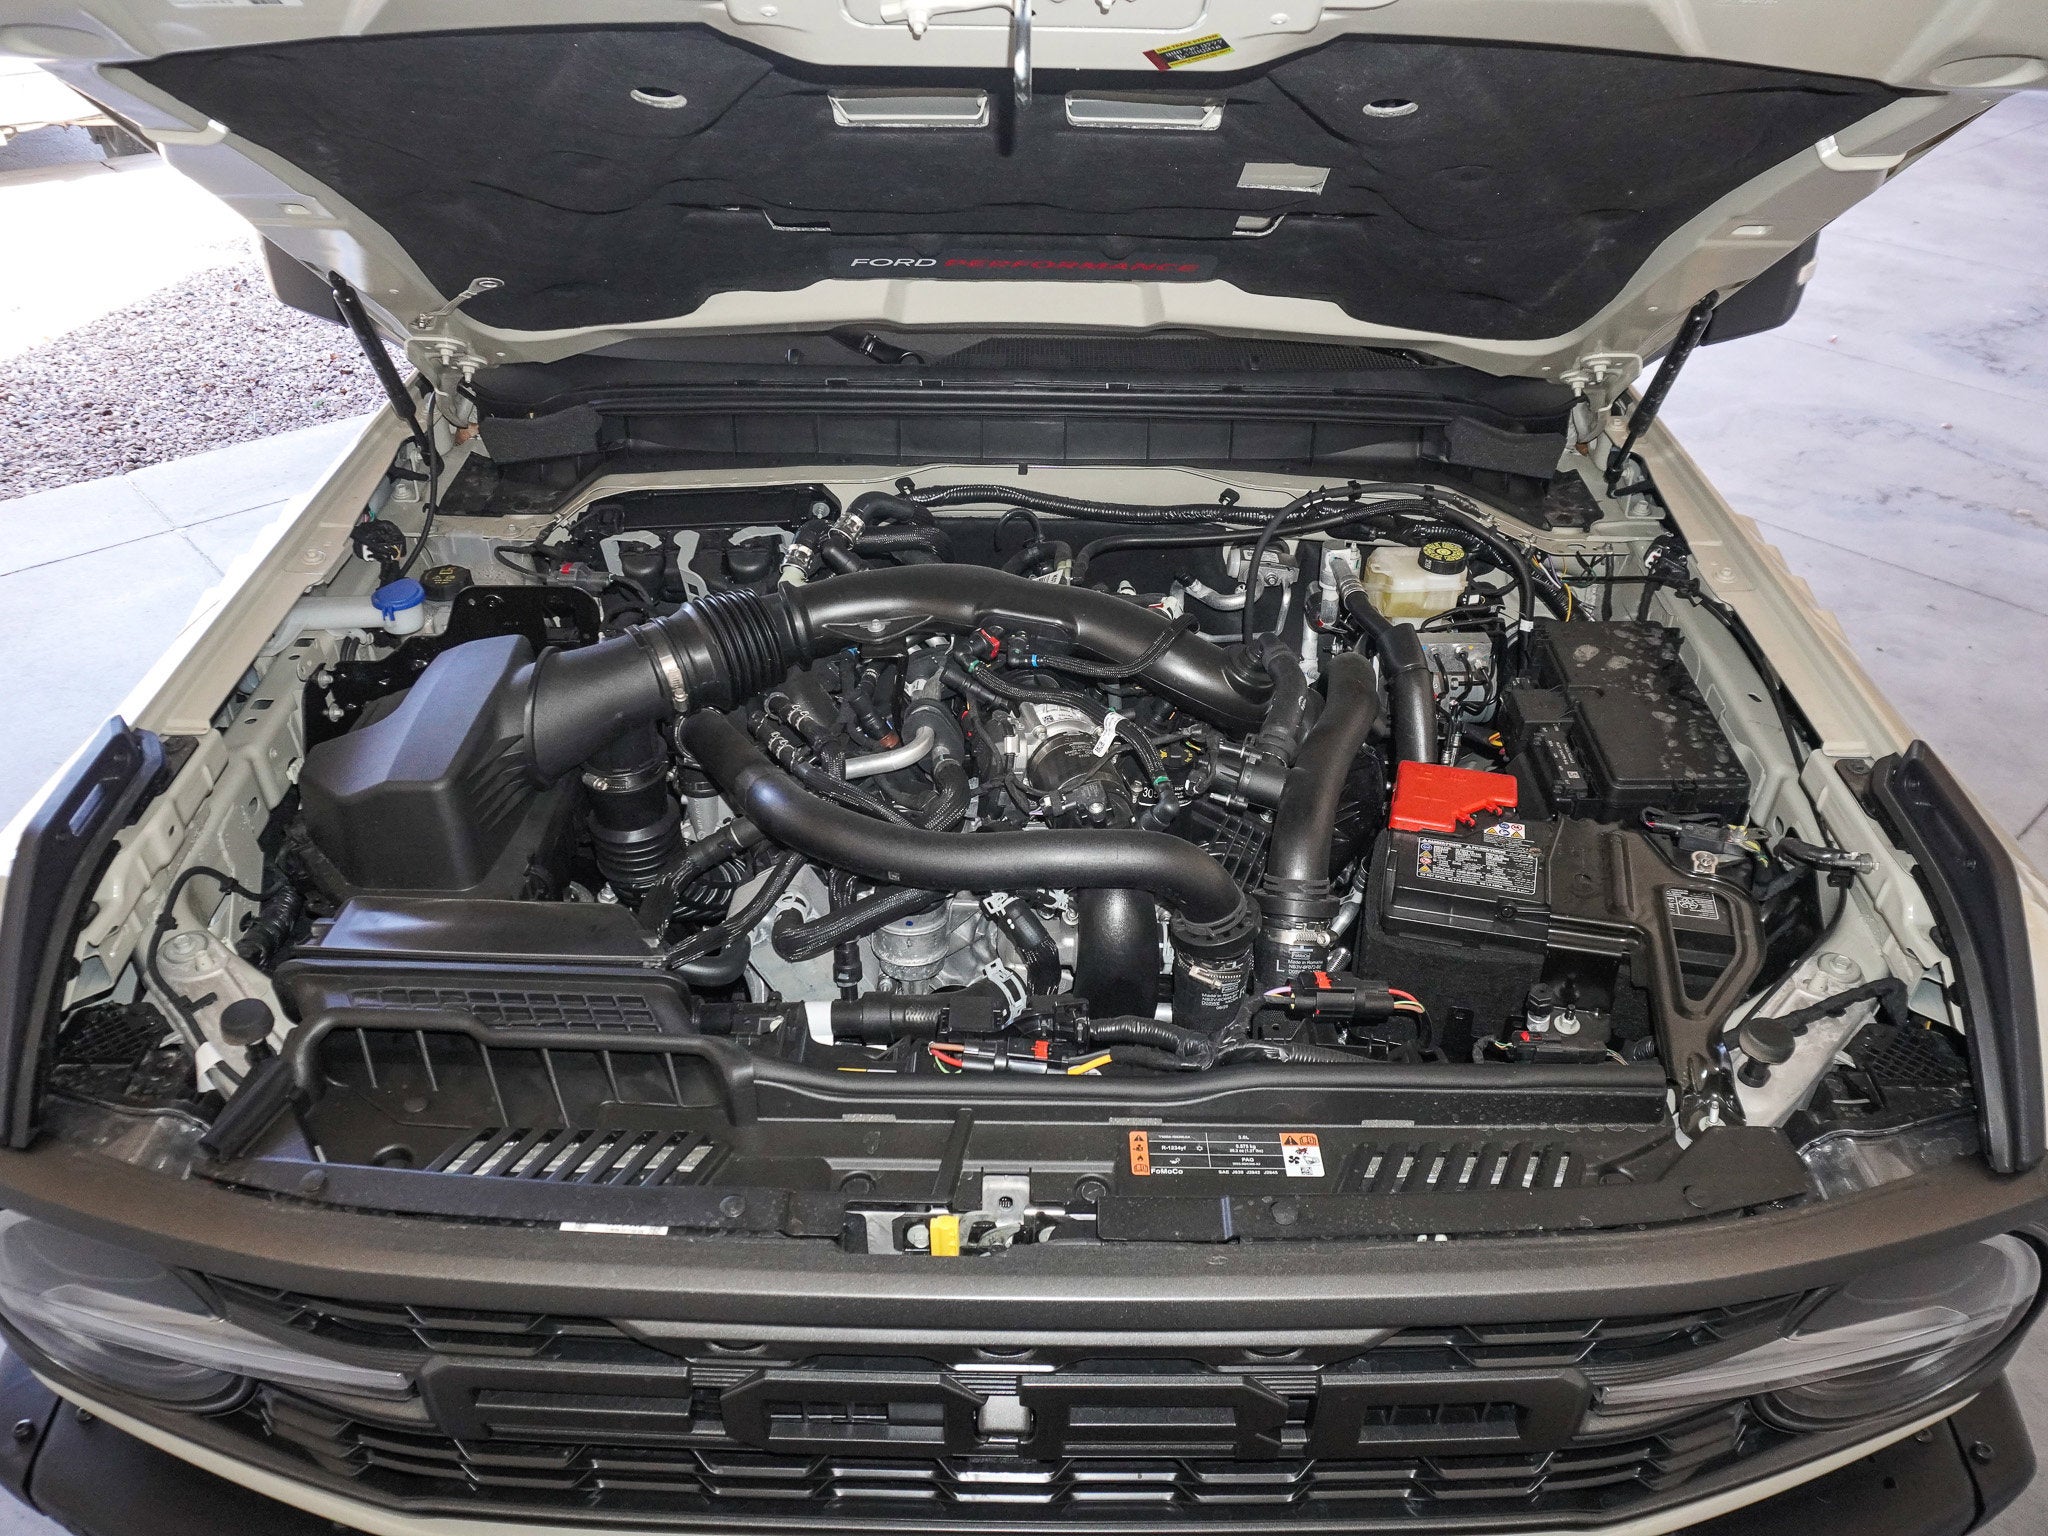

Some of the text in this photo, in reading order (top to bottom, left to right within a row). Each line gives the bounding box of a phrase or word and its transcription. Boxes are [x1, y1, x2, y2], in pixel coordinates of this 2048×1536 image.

[850, 258, 1201, 273] FORD PERFORMANCE
[1276, 960, 1284, 972] L
